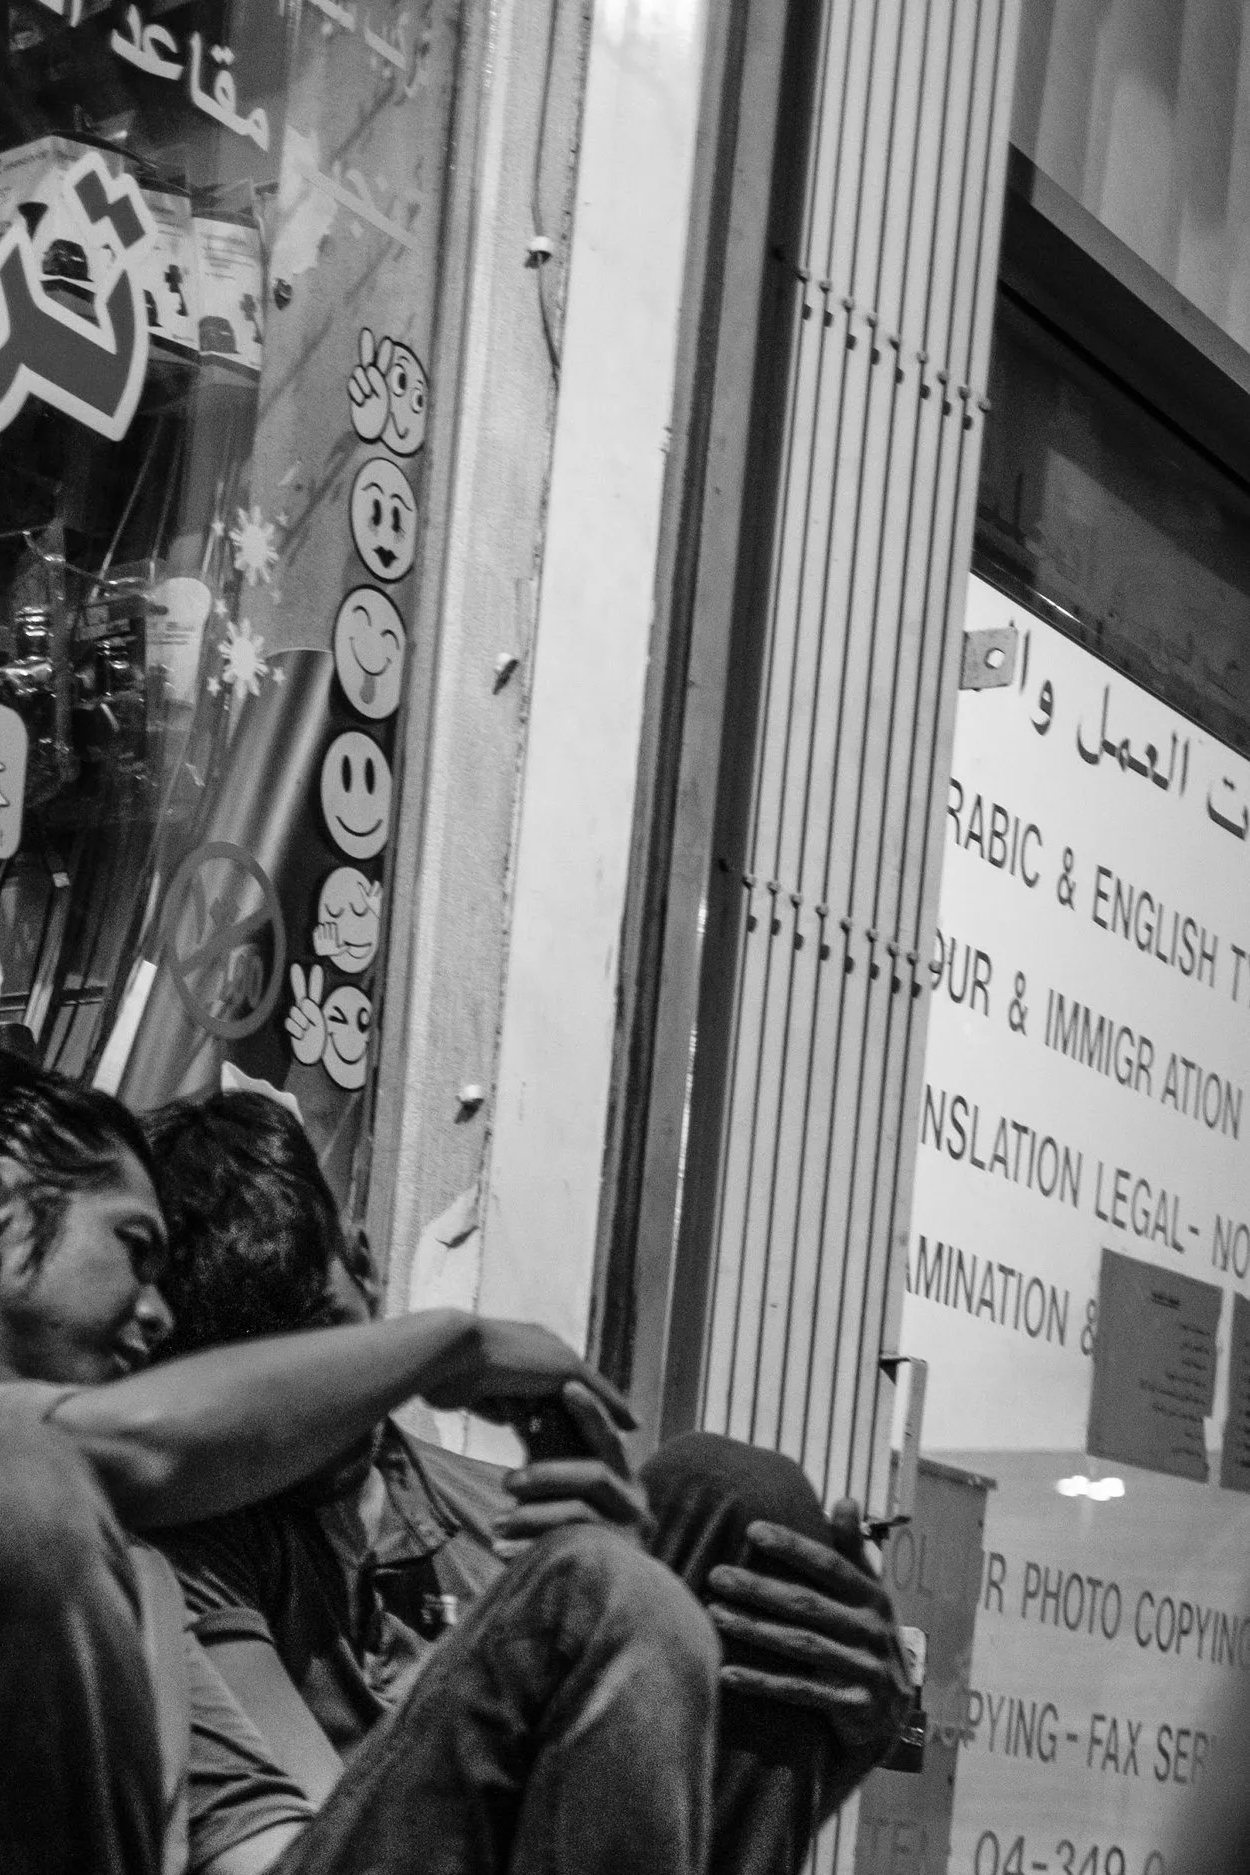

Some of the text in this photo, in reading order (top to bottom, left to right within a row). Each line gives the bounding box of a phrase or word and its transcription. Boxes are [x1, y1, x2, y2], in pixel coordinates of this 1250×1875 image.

[1076, 683, 1190, 797] العمل
[1056, 846, 1078, 911] &
[1092, 864, 1219, 989] ENGLISH
[1008, 970, 1028, 1036] &
[922, 1083, 1083, 1209] NSLATION
[906, 1235, 1070, 1347] MINATION
[1021, 1560, 1124, 1642] PHOTO
